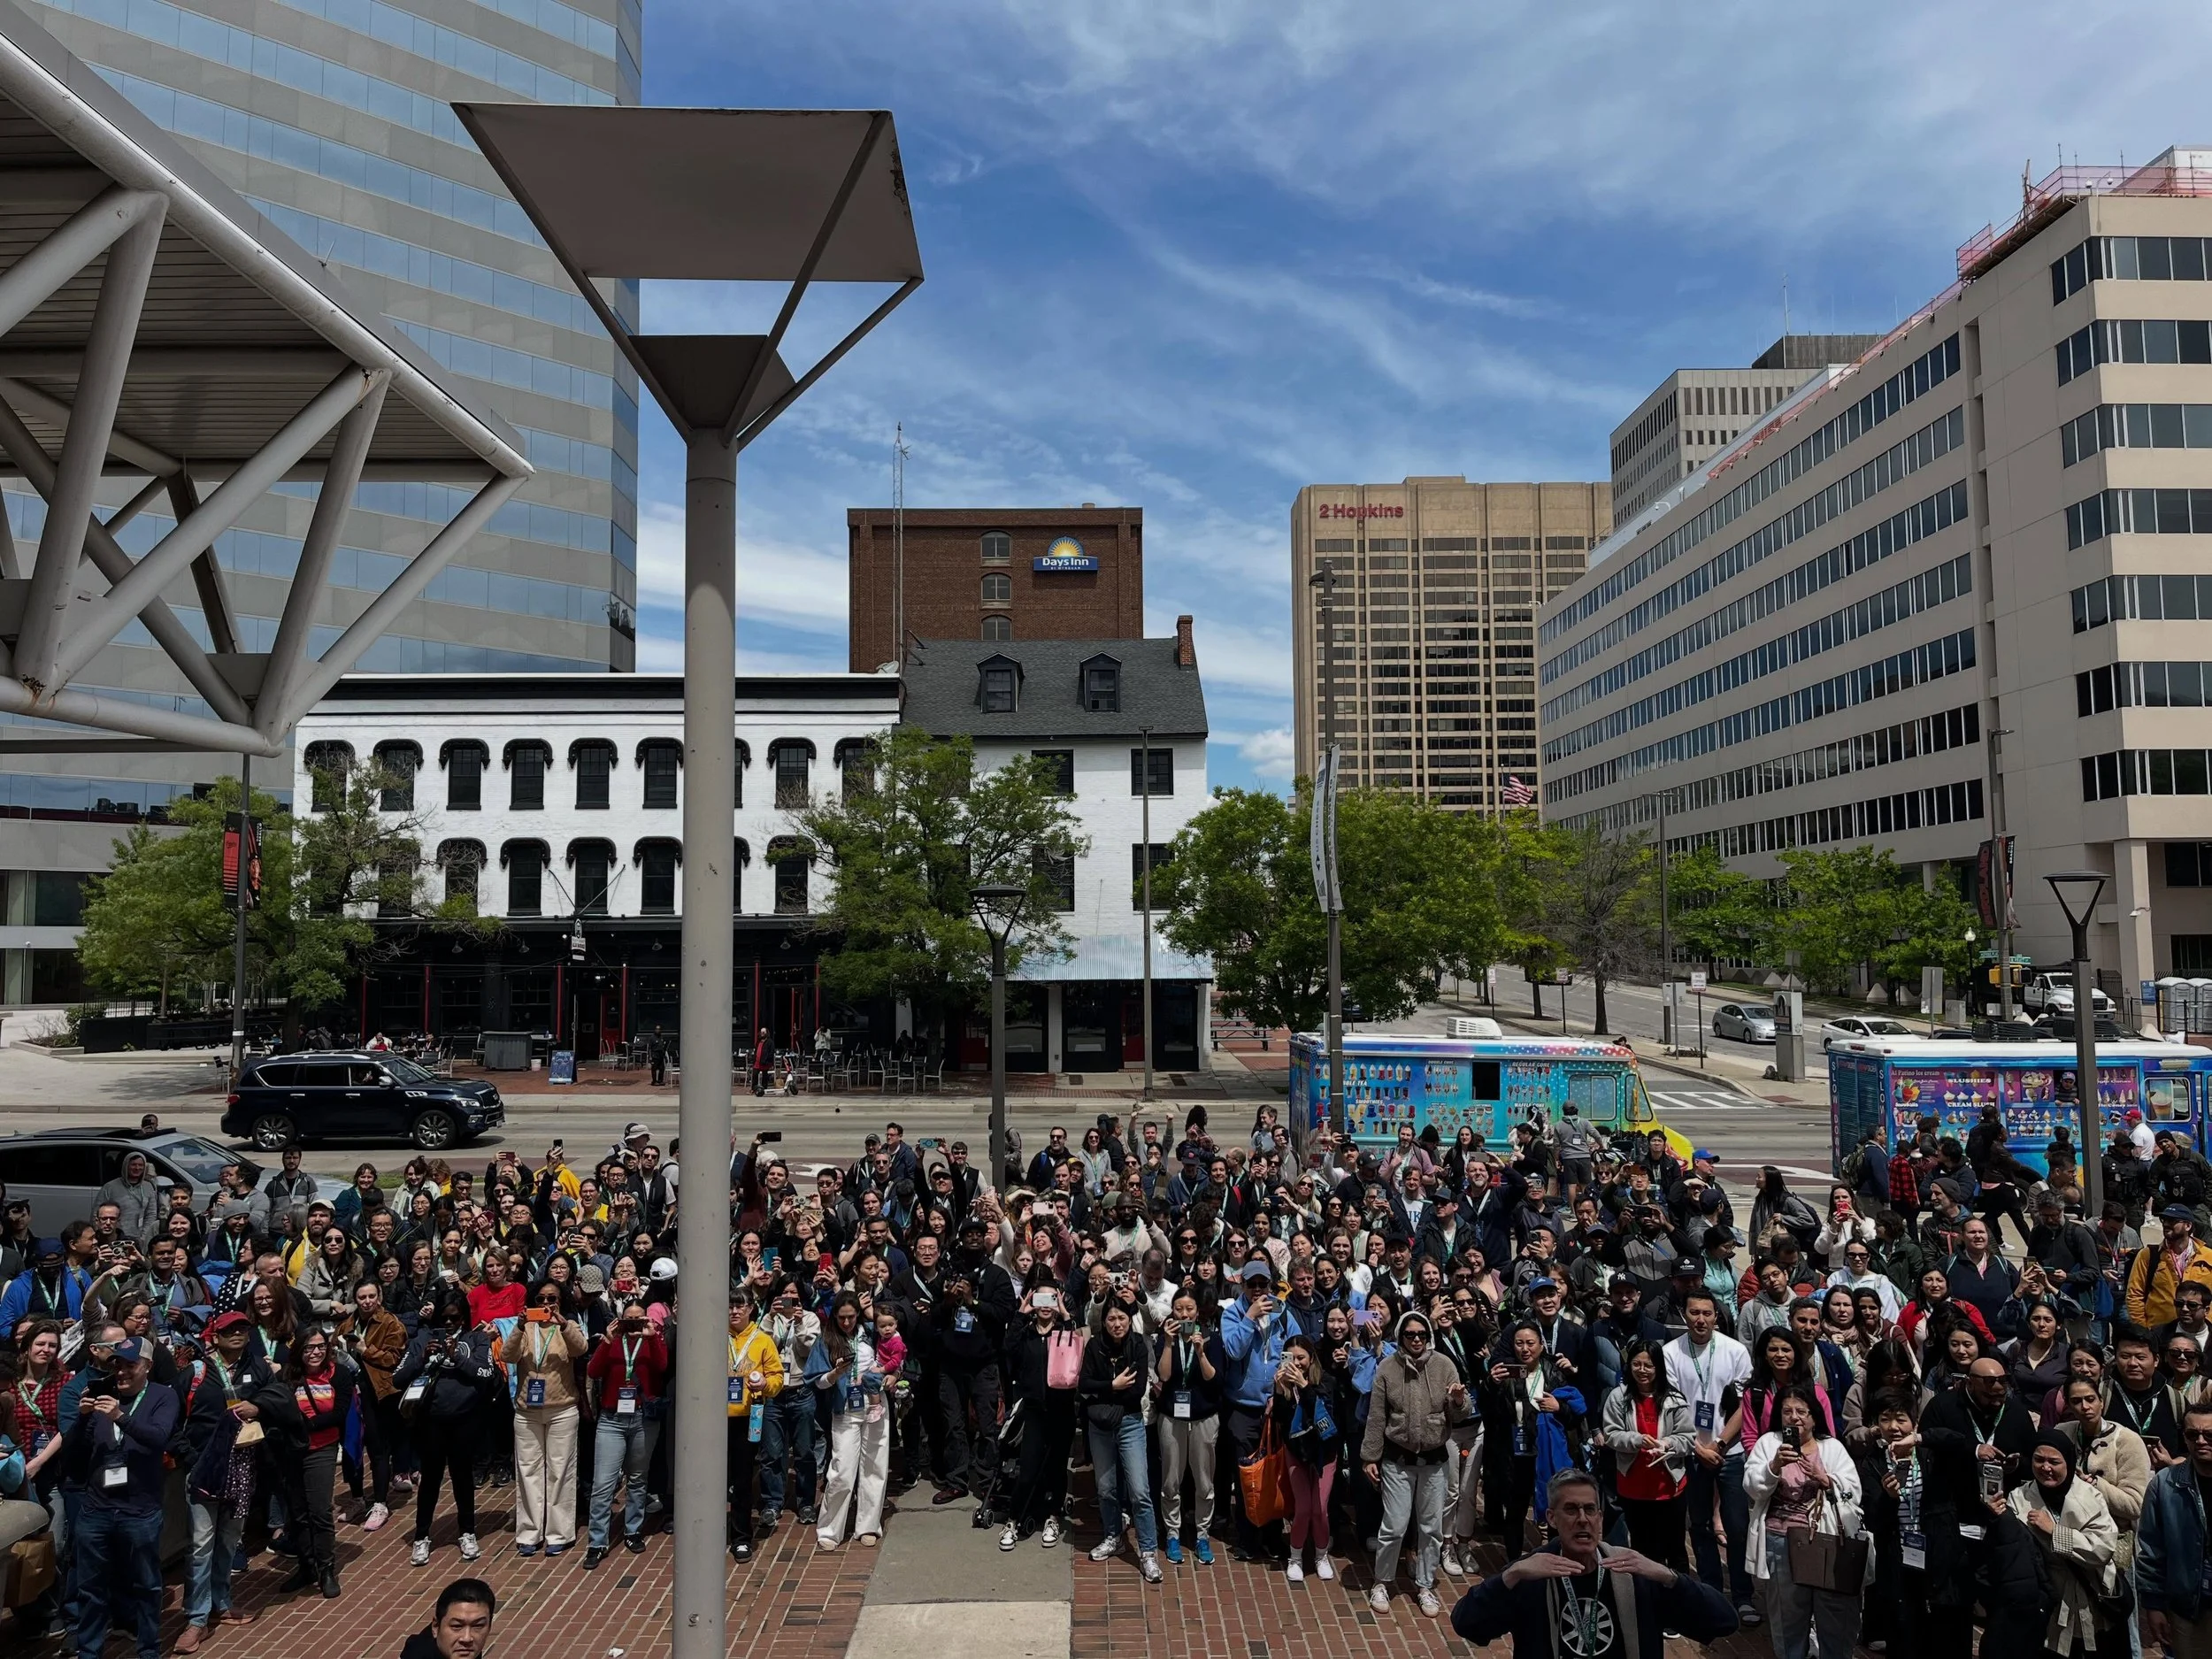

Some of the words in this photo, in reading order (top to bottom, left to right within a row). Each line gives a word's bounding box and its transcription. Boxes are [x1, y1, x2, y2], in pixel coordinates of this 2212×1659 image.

[1319, 504, 1329, 518] 2
[1333, 503, 1404, 519] Hopkins
[1042, 557, 1069, 566] Days
[1071, 557, 1089, 566] Inn
